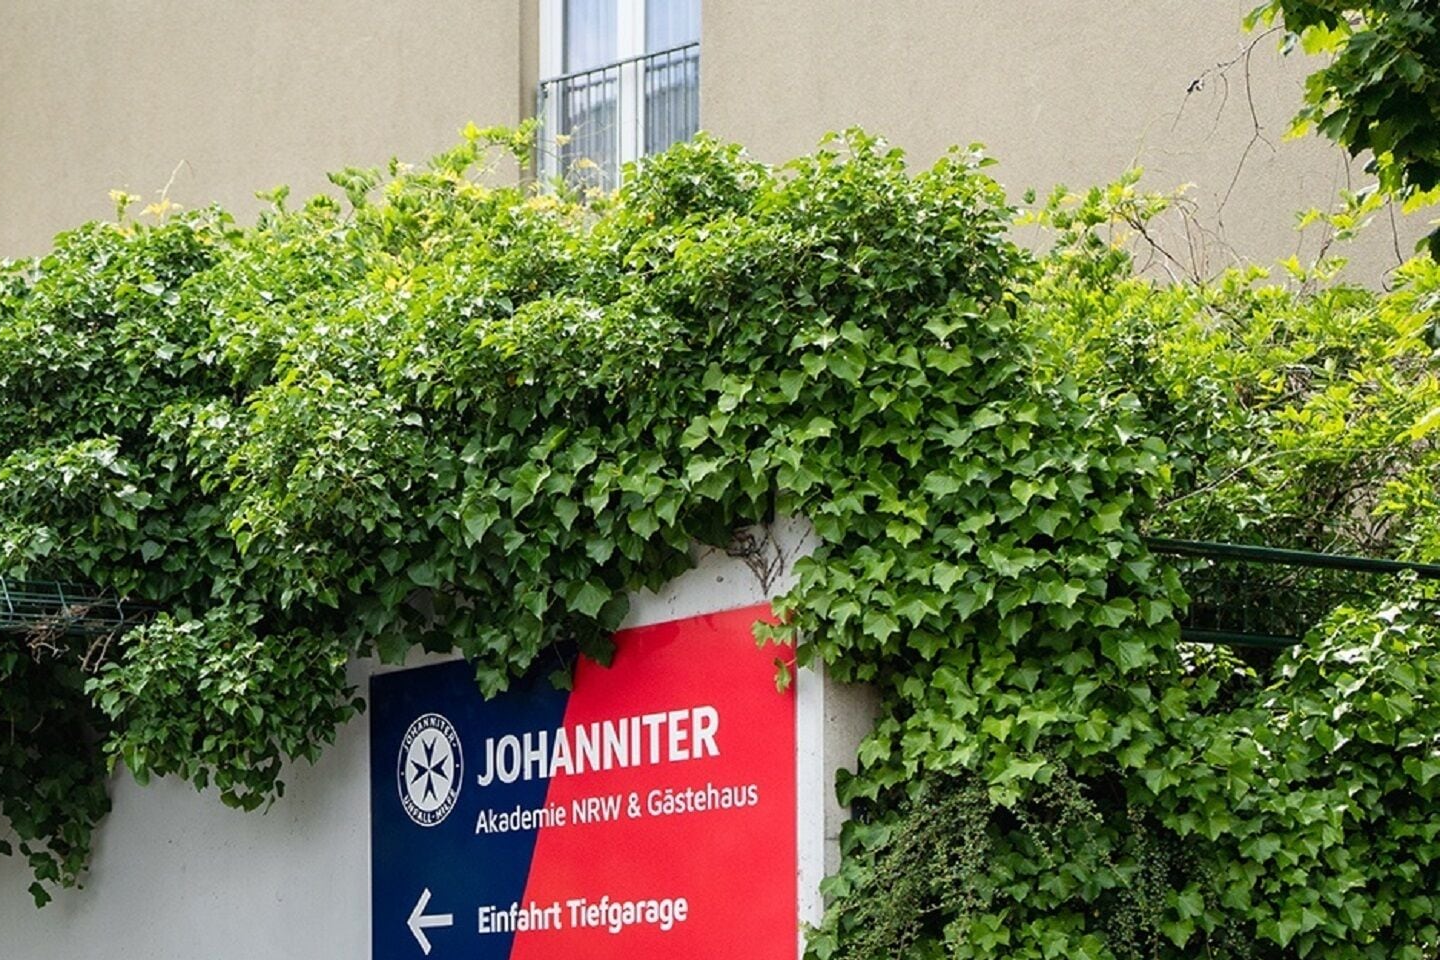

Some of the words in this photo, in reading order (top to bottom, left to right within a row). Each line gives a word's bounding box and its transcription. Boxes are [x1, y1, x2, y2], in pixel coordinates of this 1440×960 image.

[477, 705, 720, 787] JOHANNITER
[475, 802, 566, 834] Akademie
[572, 794, 622, 825] NRW
[628, 793, 642, 819] &
[647, 782, 759, 814] Gästehaus
[477, 901, 562, 934] Einfahrt
[566, 894, 689, 934] Tiefgarage
